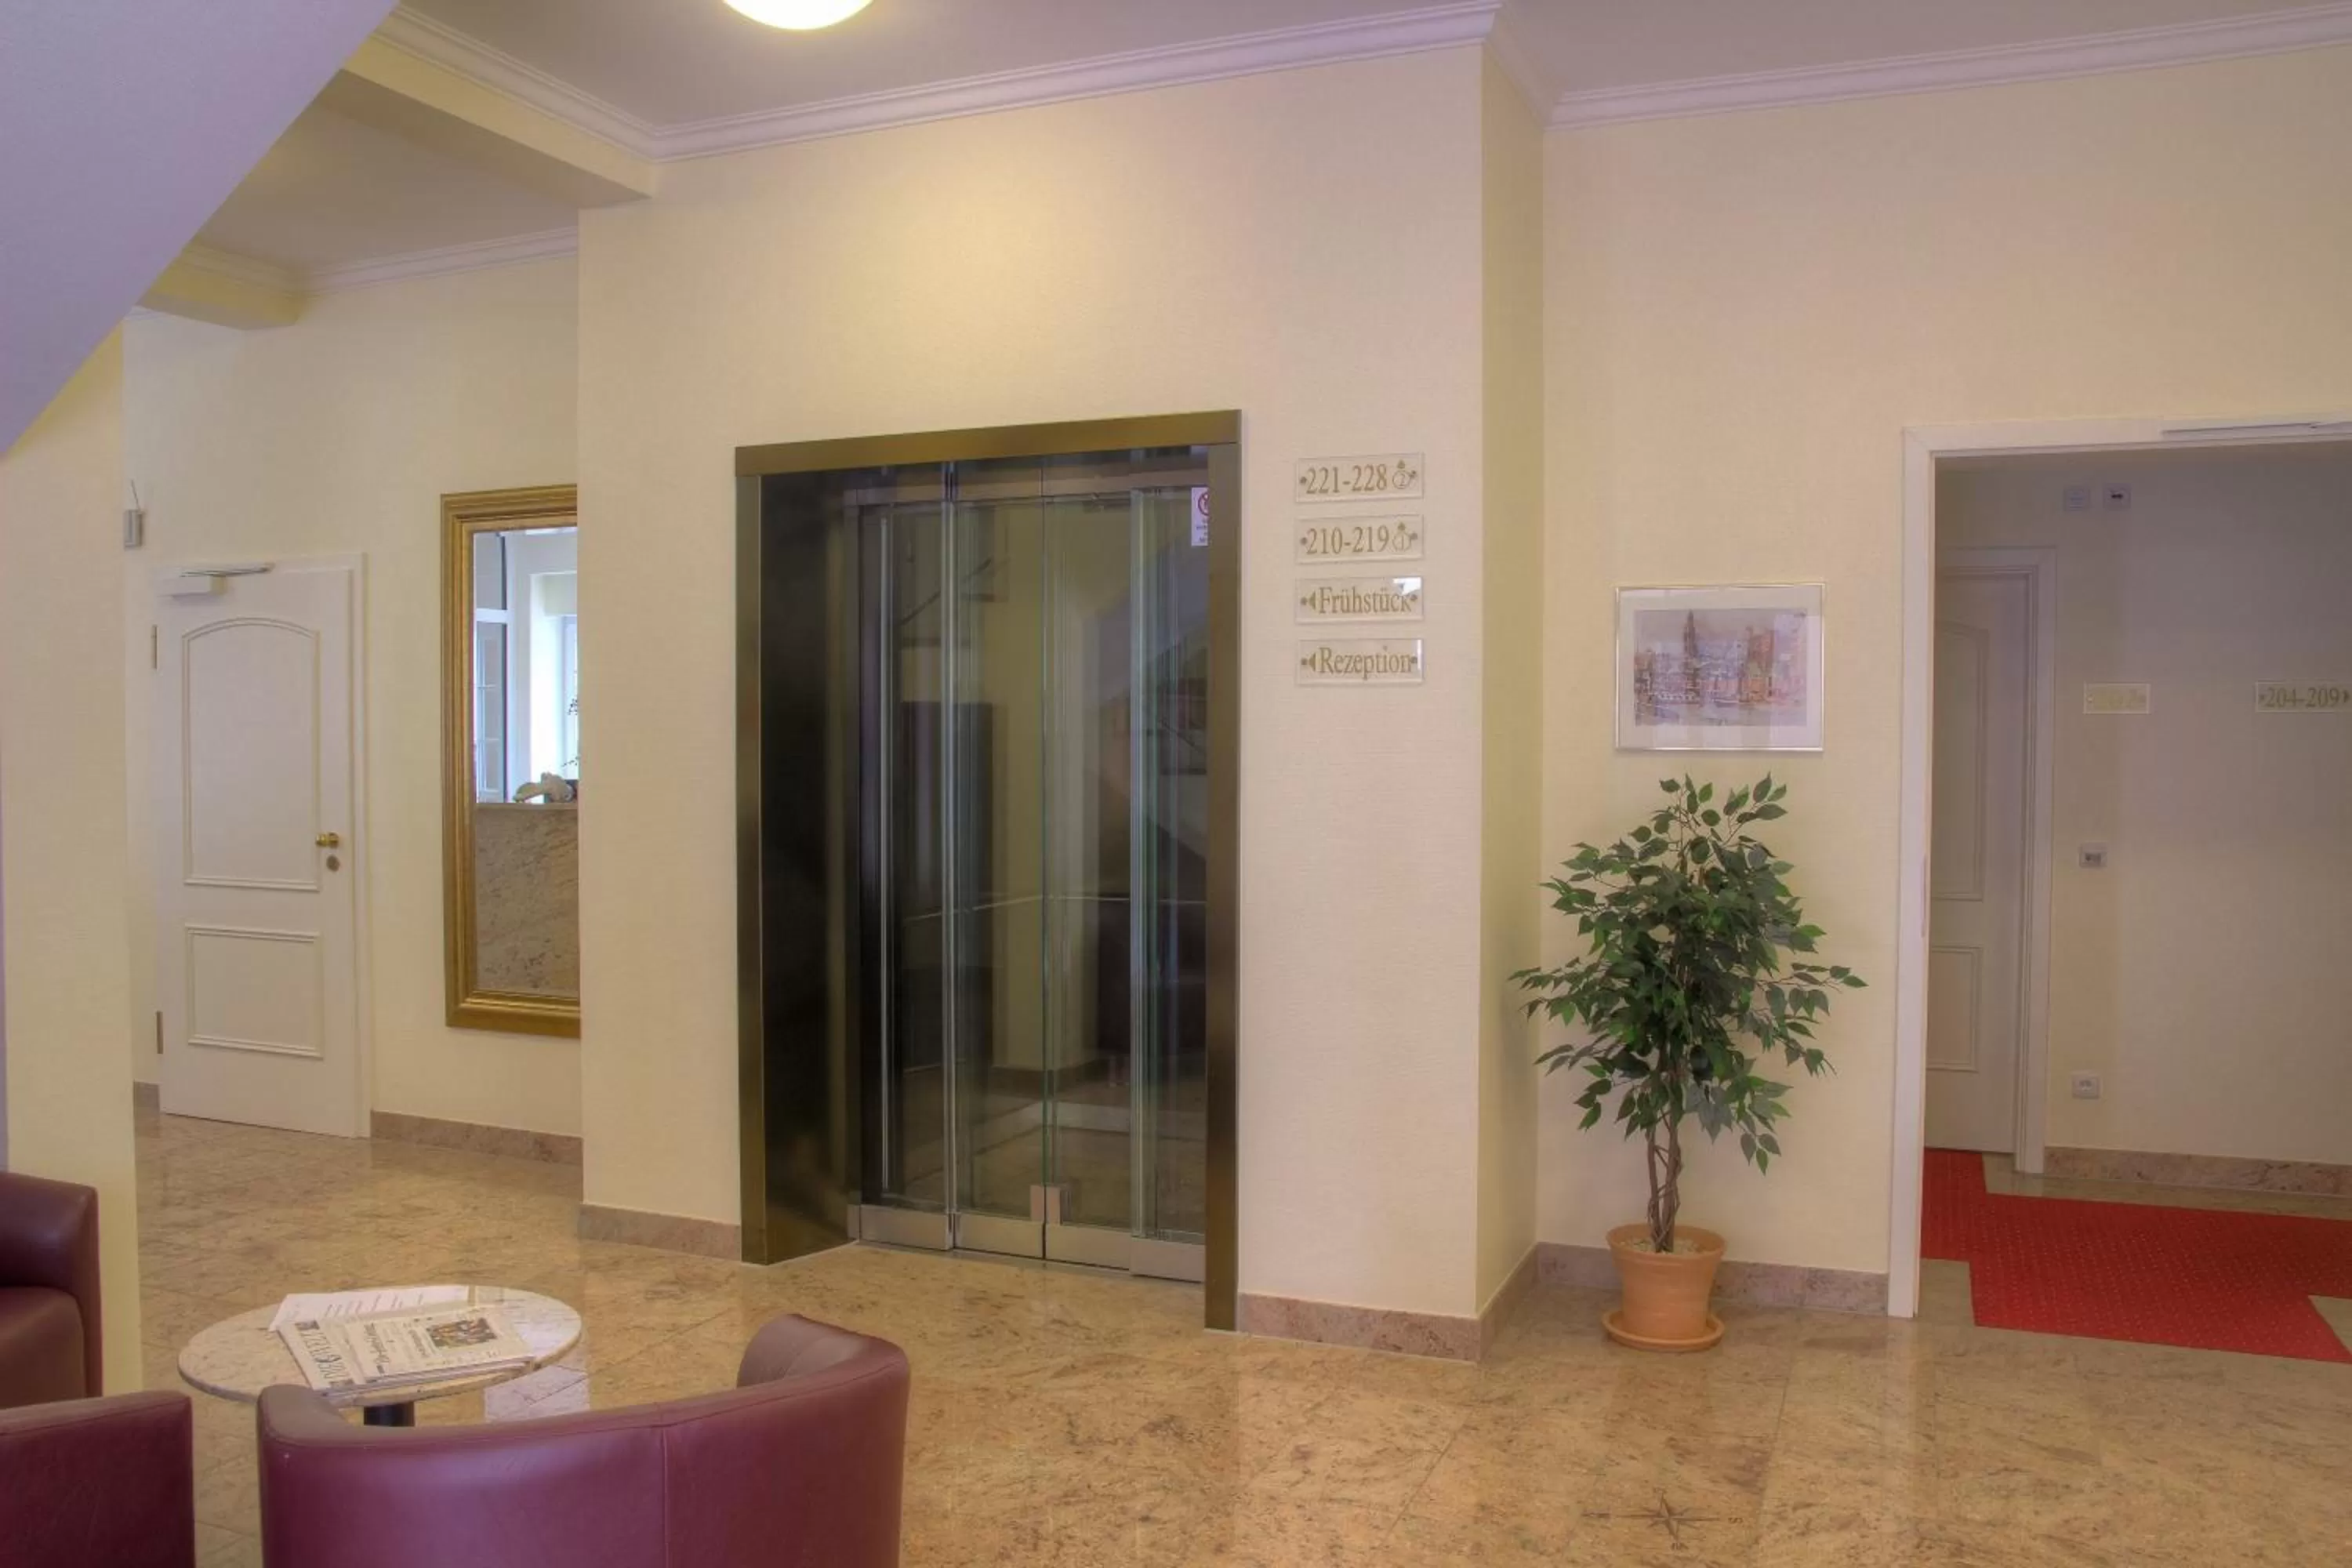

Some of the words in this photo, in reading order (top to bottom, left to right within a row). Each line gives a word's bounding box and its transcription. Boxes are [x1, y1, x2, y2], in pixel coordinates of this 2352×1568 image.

[1305, 464, 1388, 494] 221-228
[1305, 524, 1389, 554] 210-219
[1318, 586, 1412, 614] Frühstück
[1318, 645, 1412, 680] Rezeption
[2264, 686, 2340, 708] 204-209
